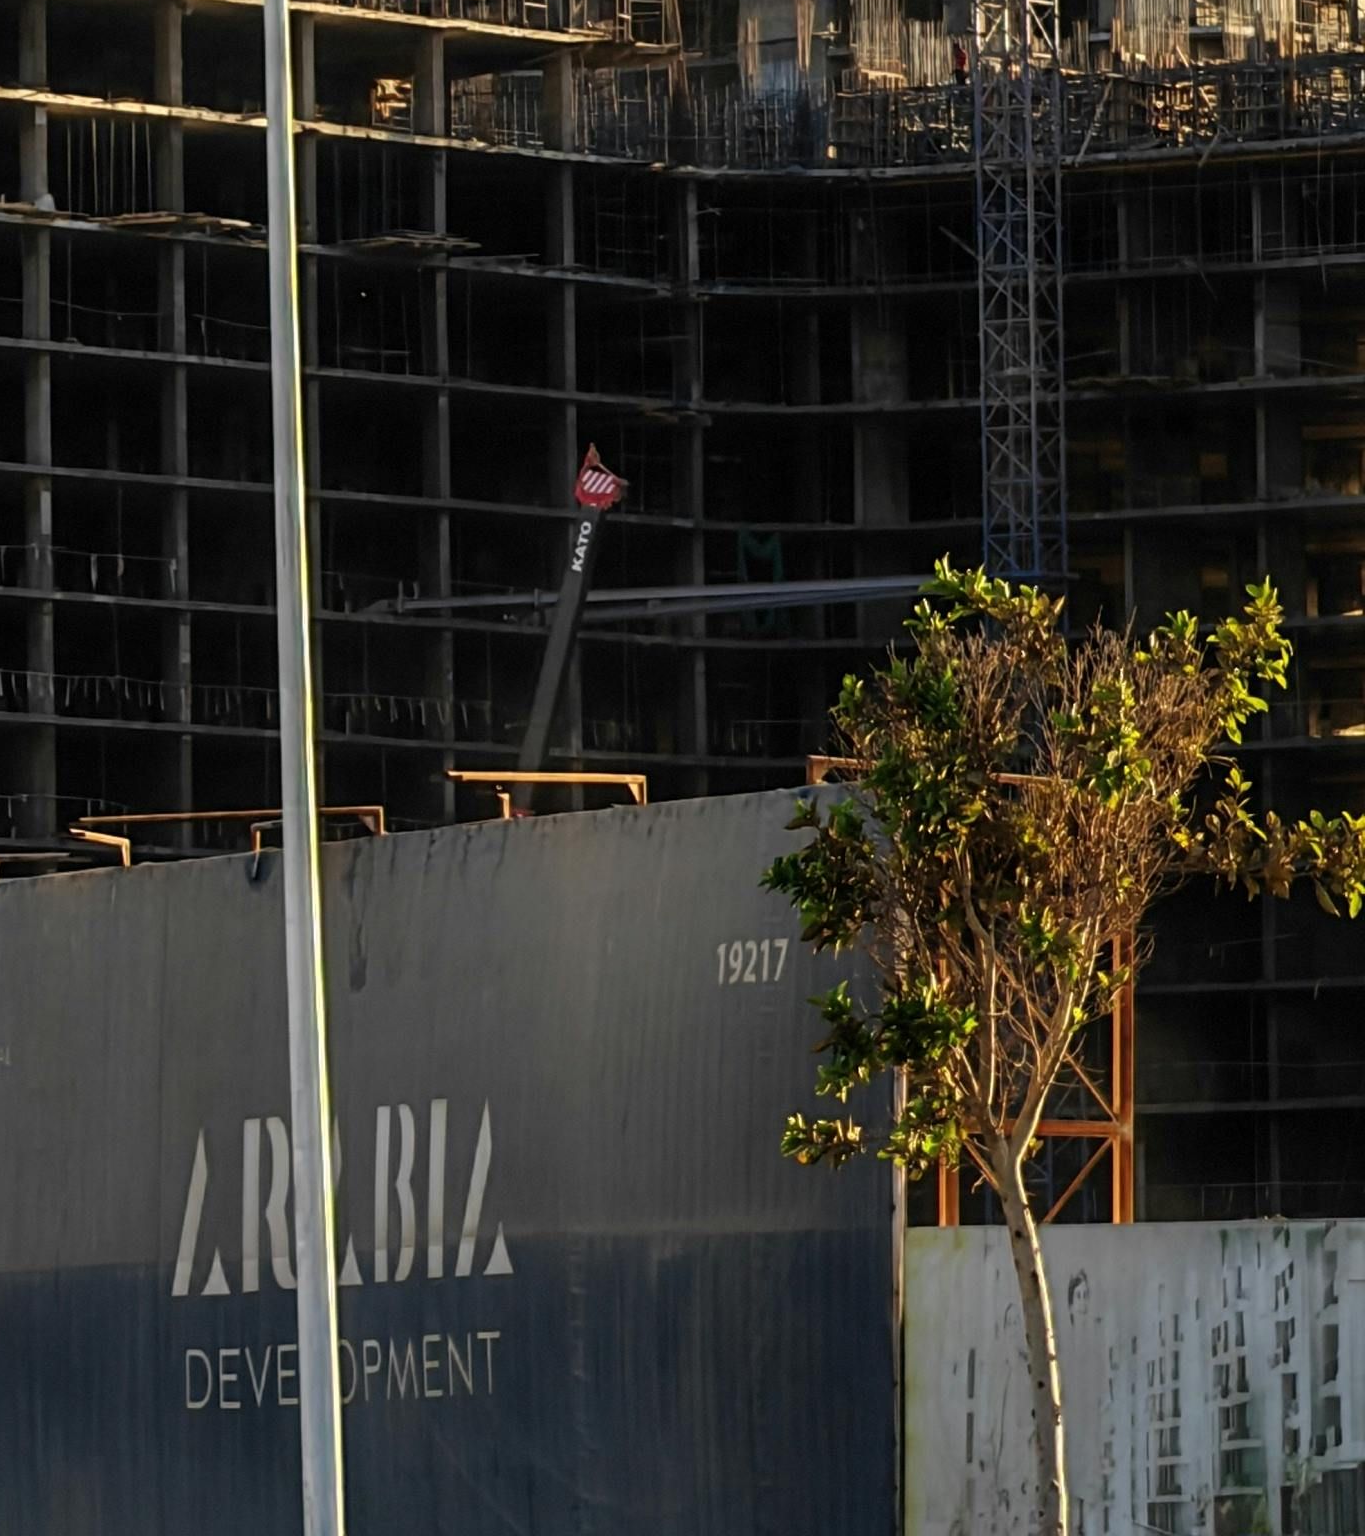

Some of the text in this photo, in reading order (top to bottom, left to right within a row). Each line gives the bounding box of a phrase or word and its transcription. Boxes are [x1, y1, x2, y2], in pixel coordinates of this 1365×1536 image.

[571, 521, 592, 572] KATO
[716, 938, 789, 986] 19217
[185, 1331, 501, 1409] DEVEOPMENT
